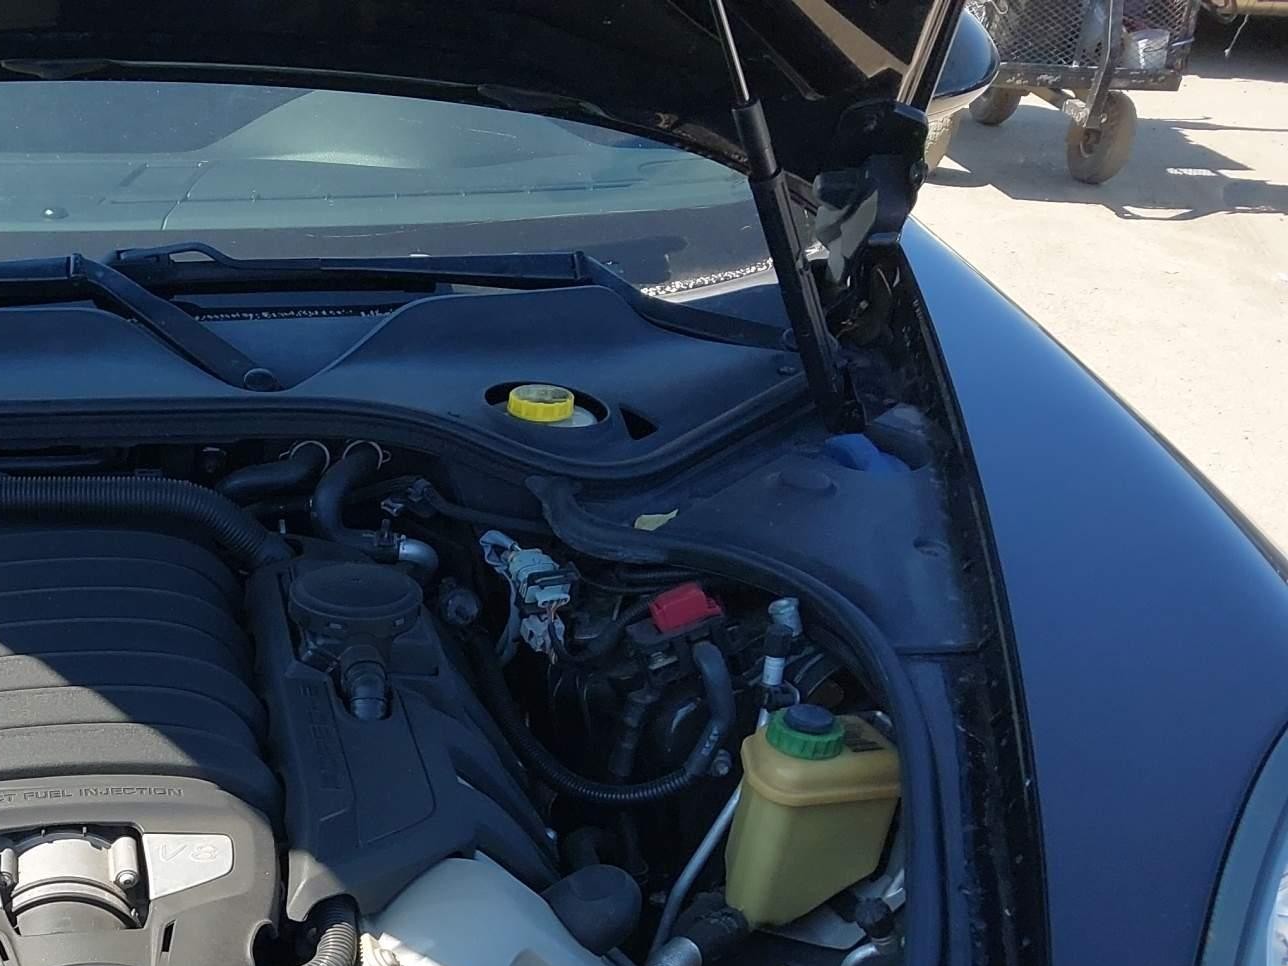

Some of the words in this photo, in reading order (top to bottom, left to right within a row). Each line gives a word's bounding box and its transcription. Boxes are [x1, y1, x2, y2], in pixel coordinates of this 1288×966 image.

[23, 787, 73, 801] FUEL
[79, 786, 184, 798] INJECTION
[159, 842, 217, 862] V8
